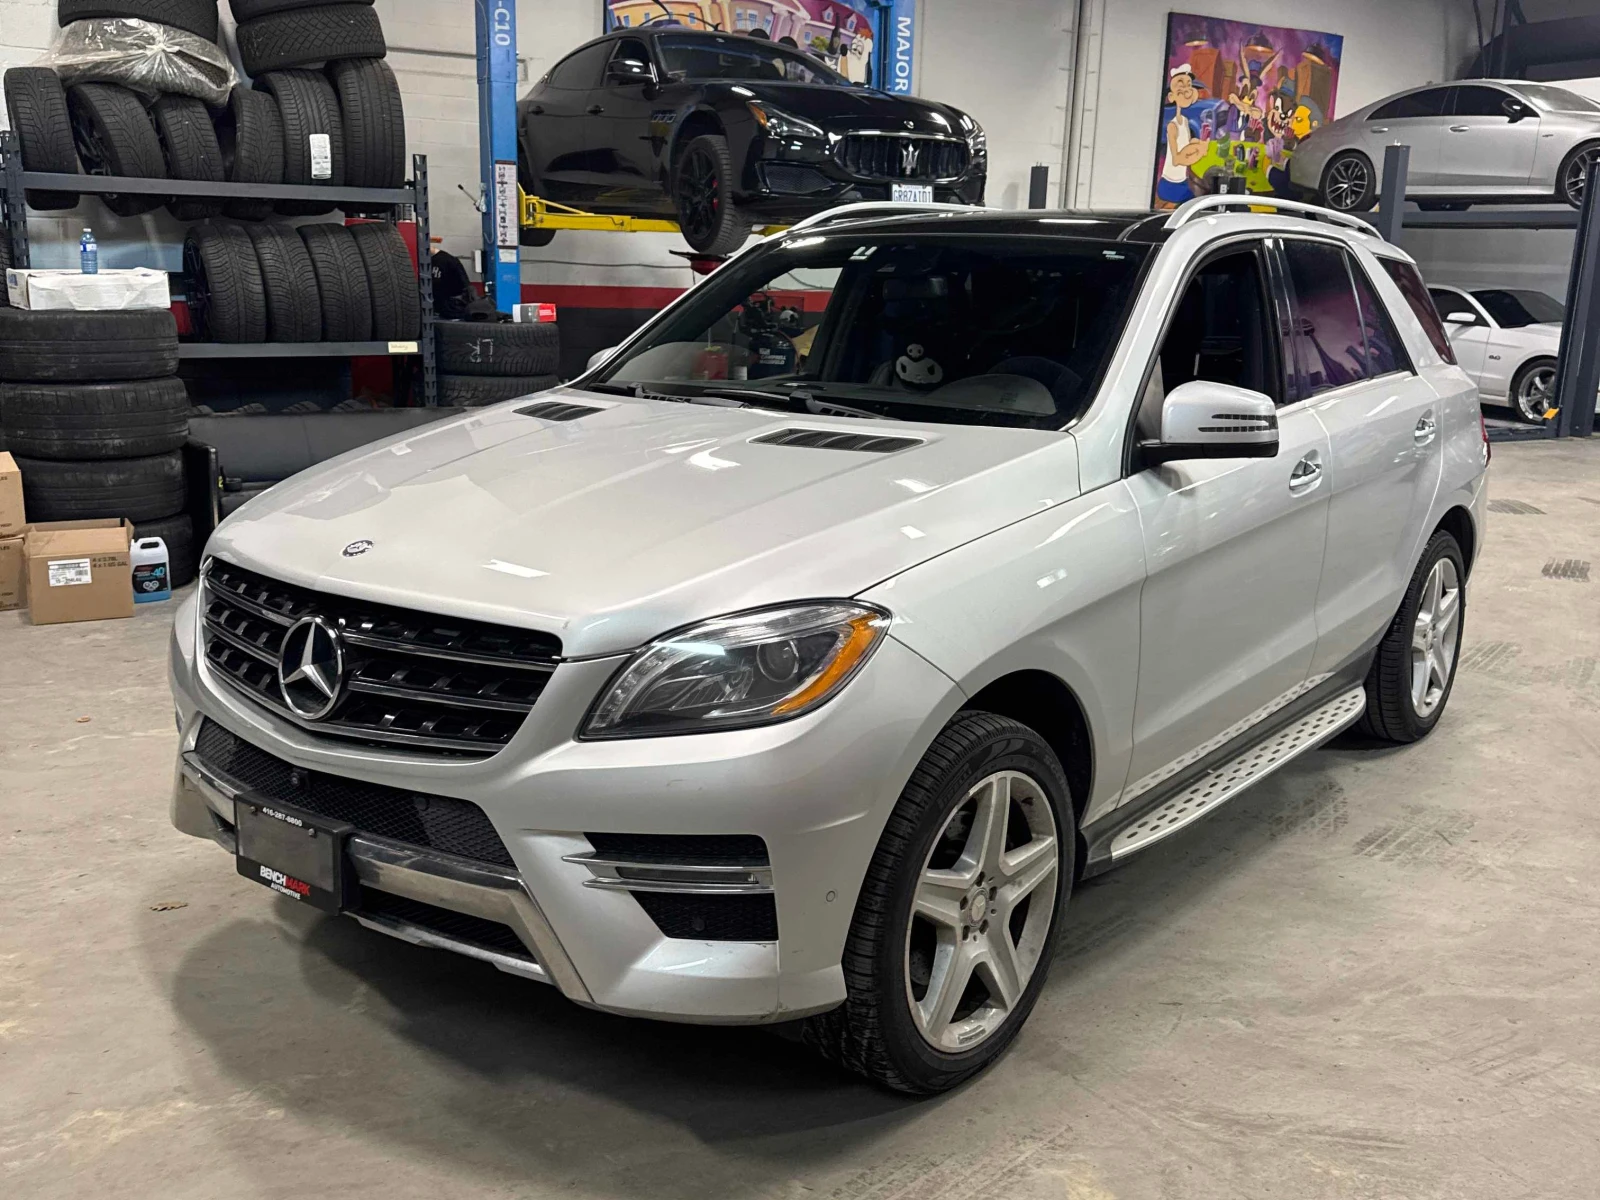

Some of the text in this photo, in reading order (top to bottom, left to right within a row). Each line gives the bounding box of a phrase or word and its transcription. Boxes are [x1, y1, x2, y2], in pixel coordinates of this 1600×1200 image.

[895, 16, 911, 91] MAJOR
[260, 865, 311, 896] BENCHMARK
[270, 882, 301, 900] AUTOMOTIVE
